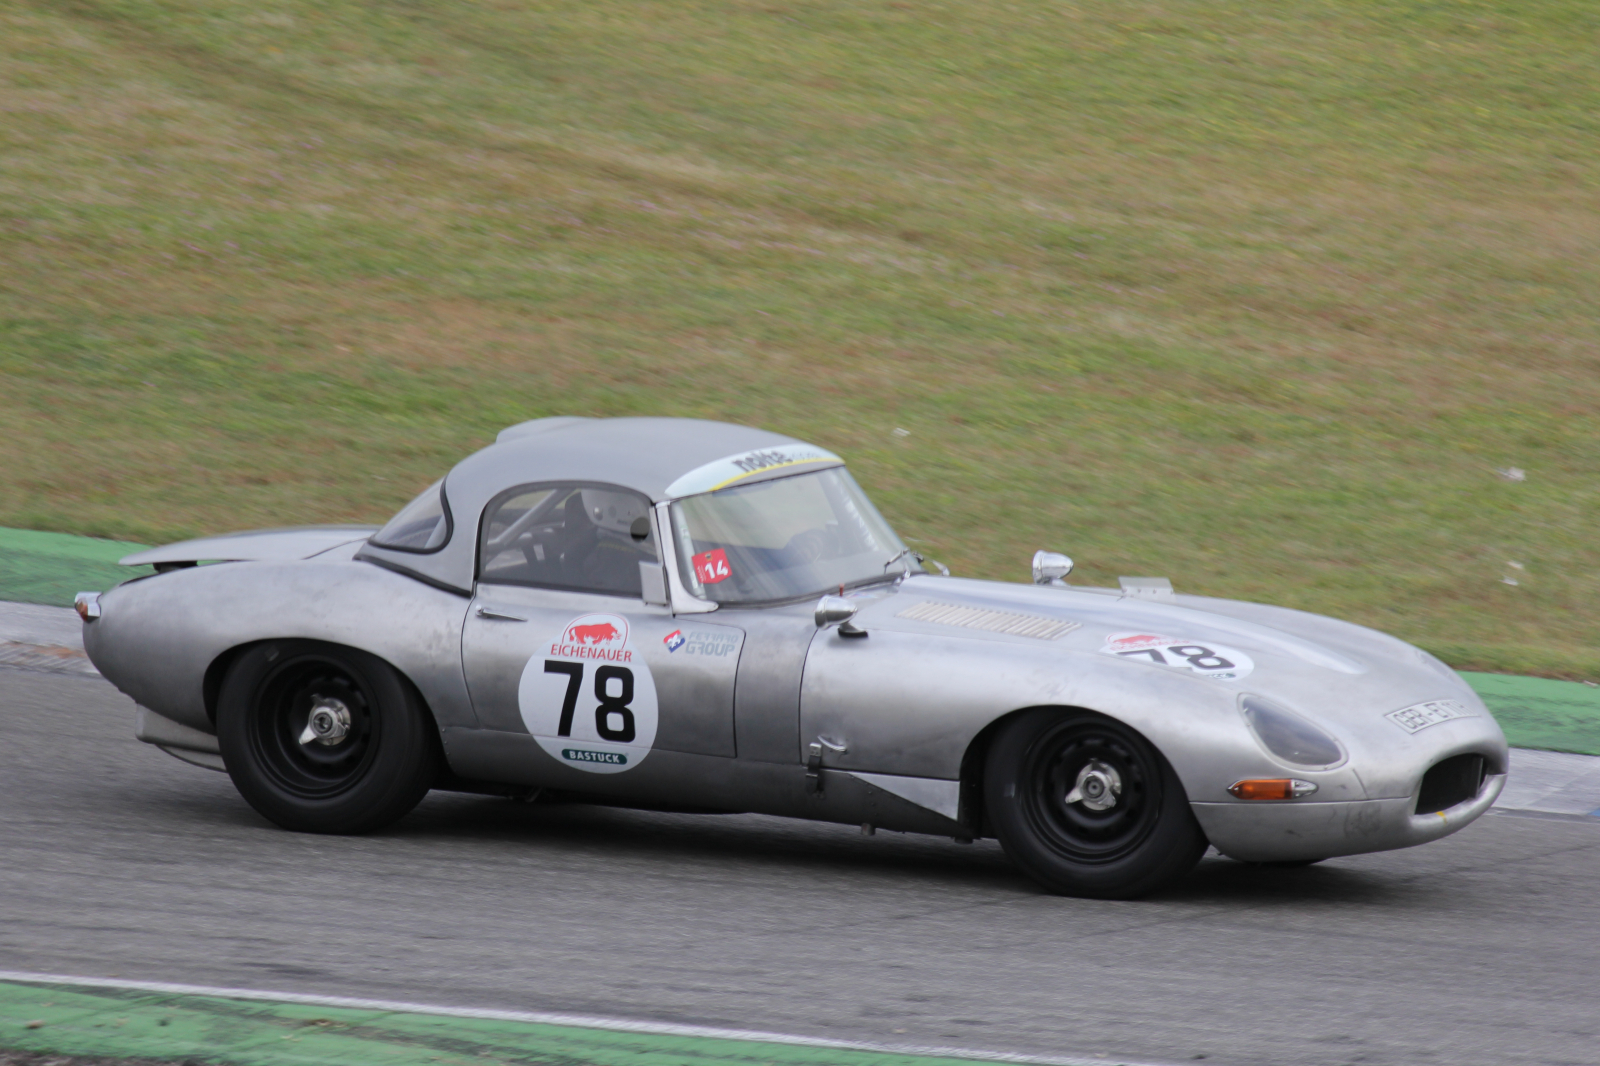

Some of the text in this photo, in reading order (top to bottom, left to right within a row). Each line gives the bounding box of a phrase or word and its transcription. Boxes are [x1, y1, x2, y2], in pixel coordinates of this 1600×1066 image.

[705, 560, 728, 579] 14
[550, 644, 632, 662] EICHENAUER
[685, 641, 736, 657] GROUP
[1115, 645, 1236, 669] 78
[544, 659, 636, 743] 78
[569, 750, 620, 763] BASTUCK
